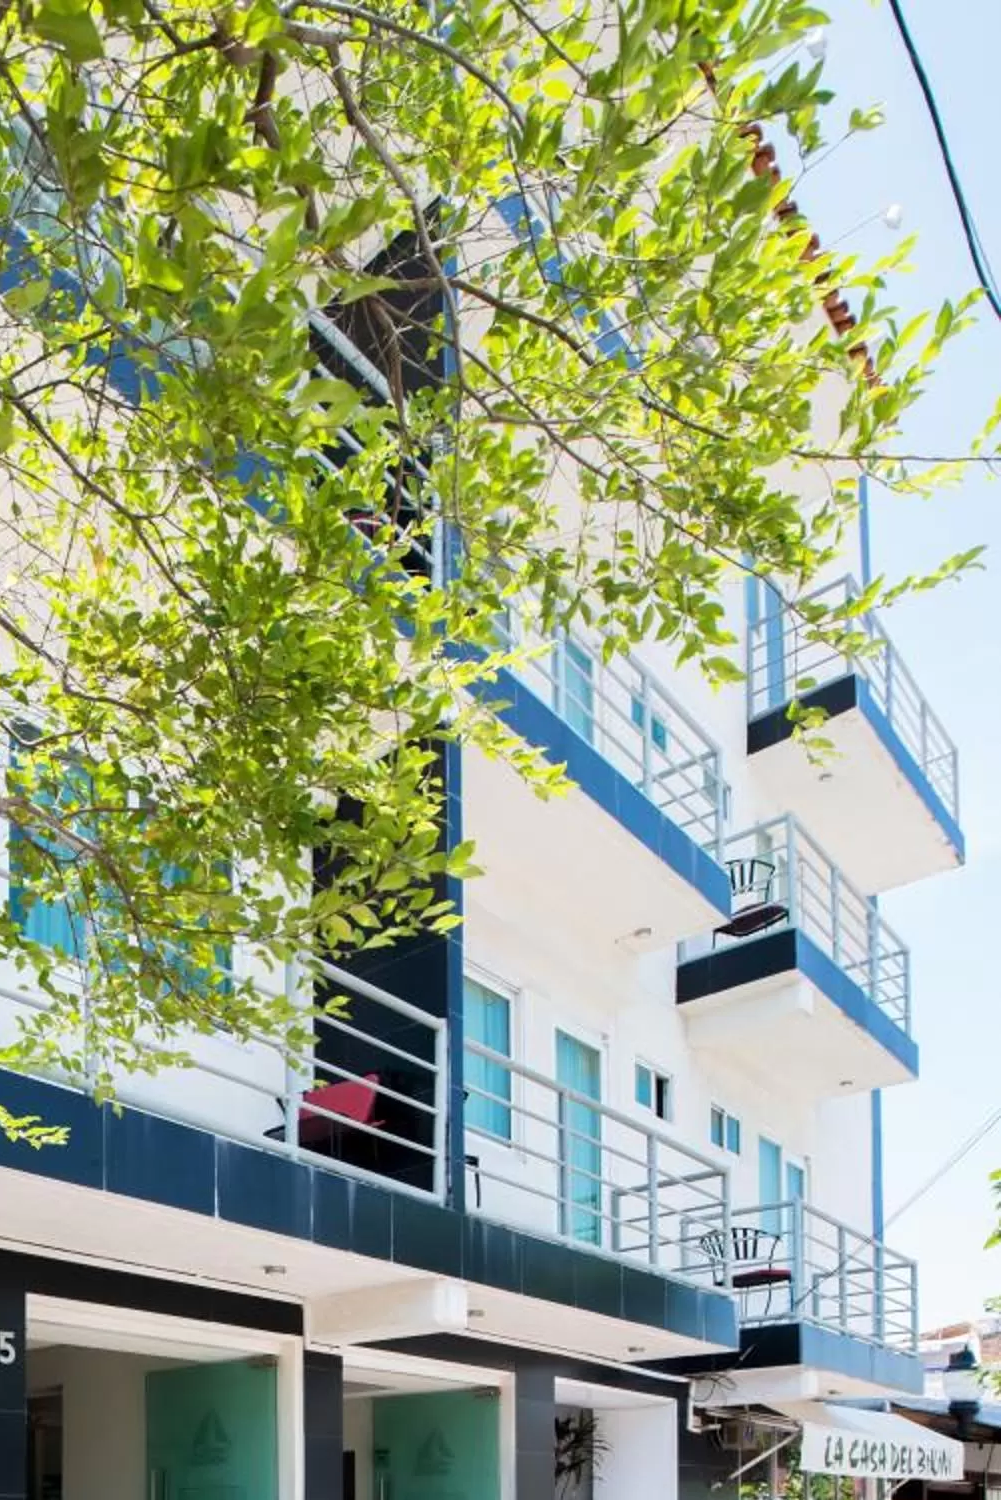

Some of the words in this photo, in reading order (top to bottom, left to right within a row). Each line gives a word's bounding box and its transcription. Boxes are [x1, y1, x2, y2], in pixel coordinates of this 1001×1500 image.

[824, 1435, 844, 1469] LA
[848, 1439, 886, 1473] CASA
[890, 1442, 913, 1474] DEL
